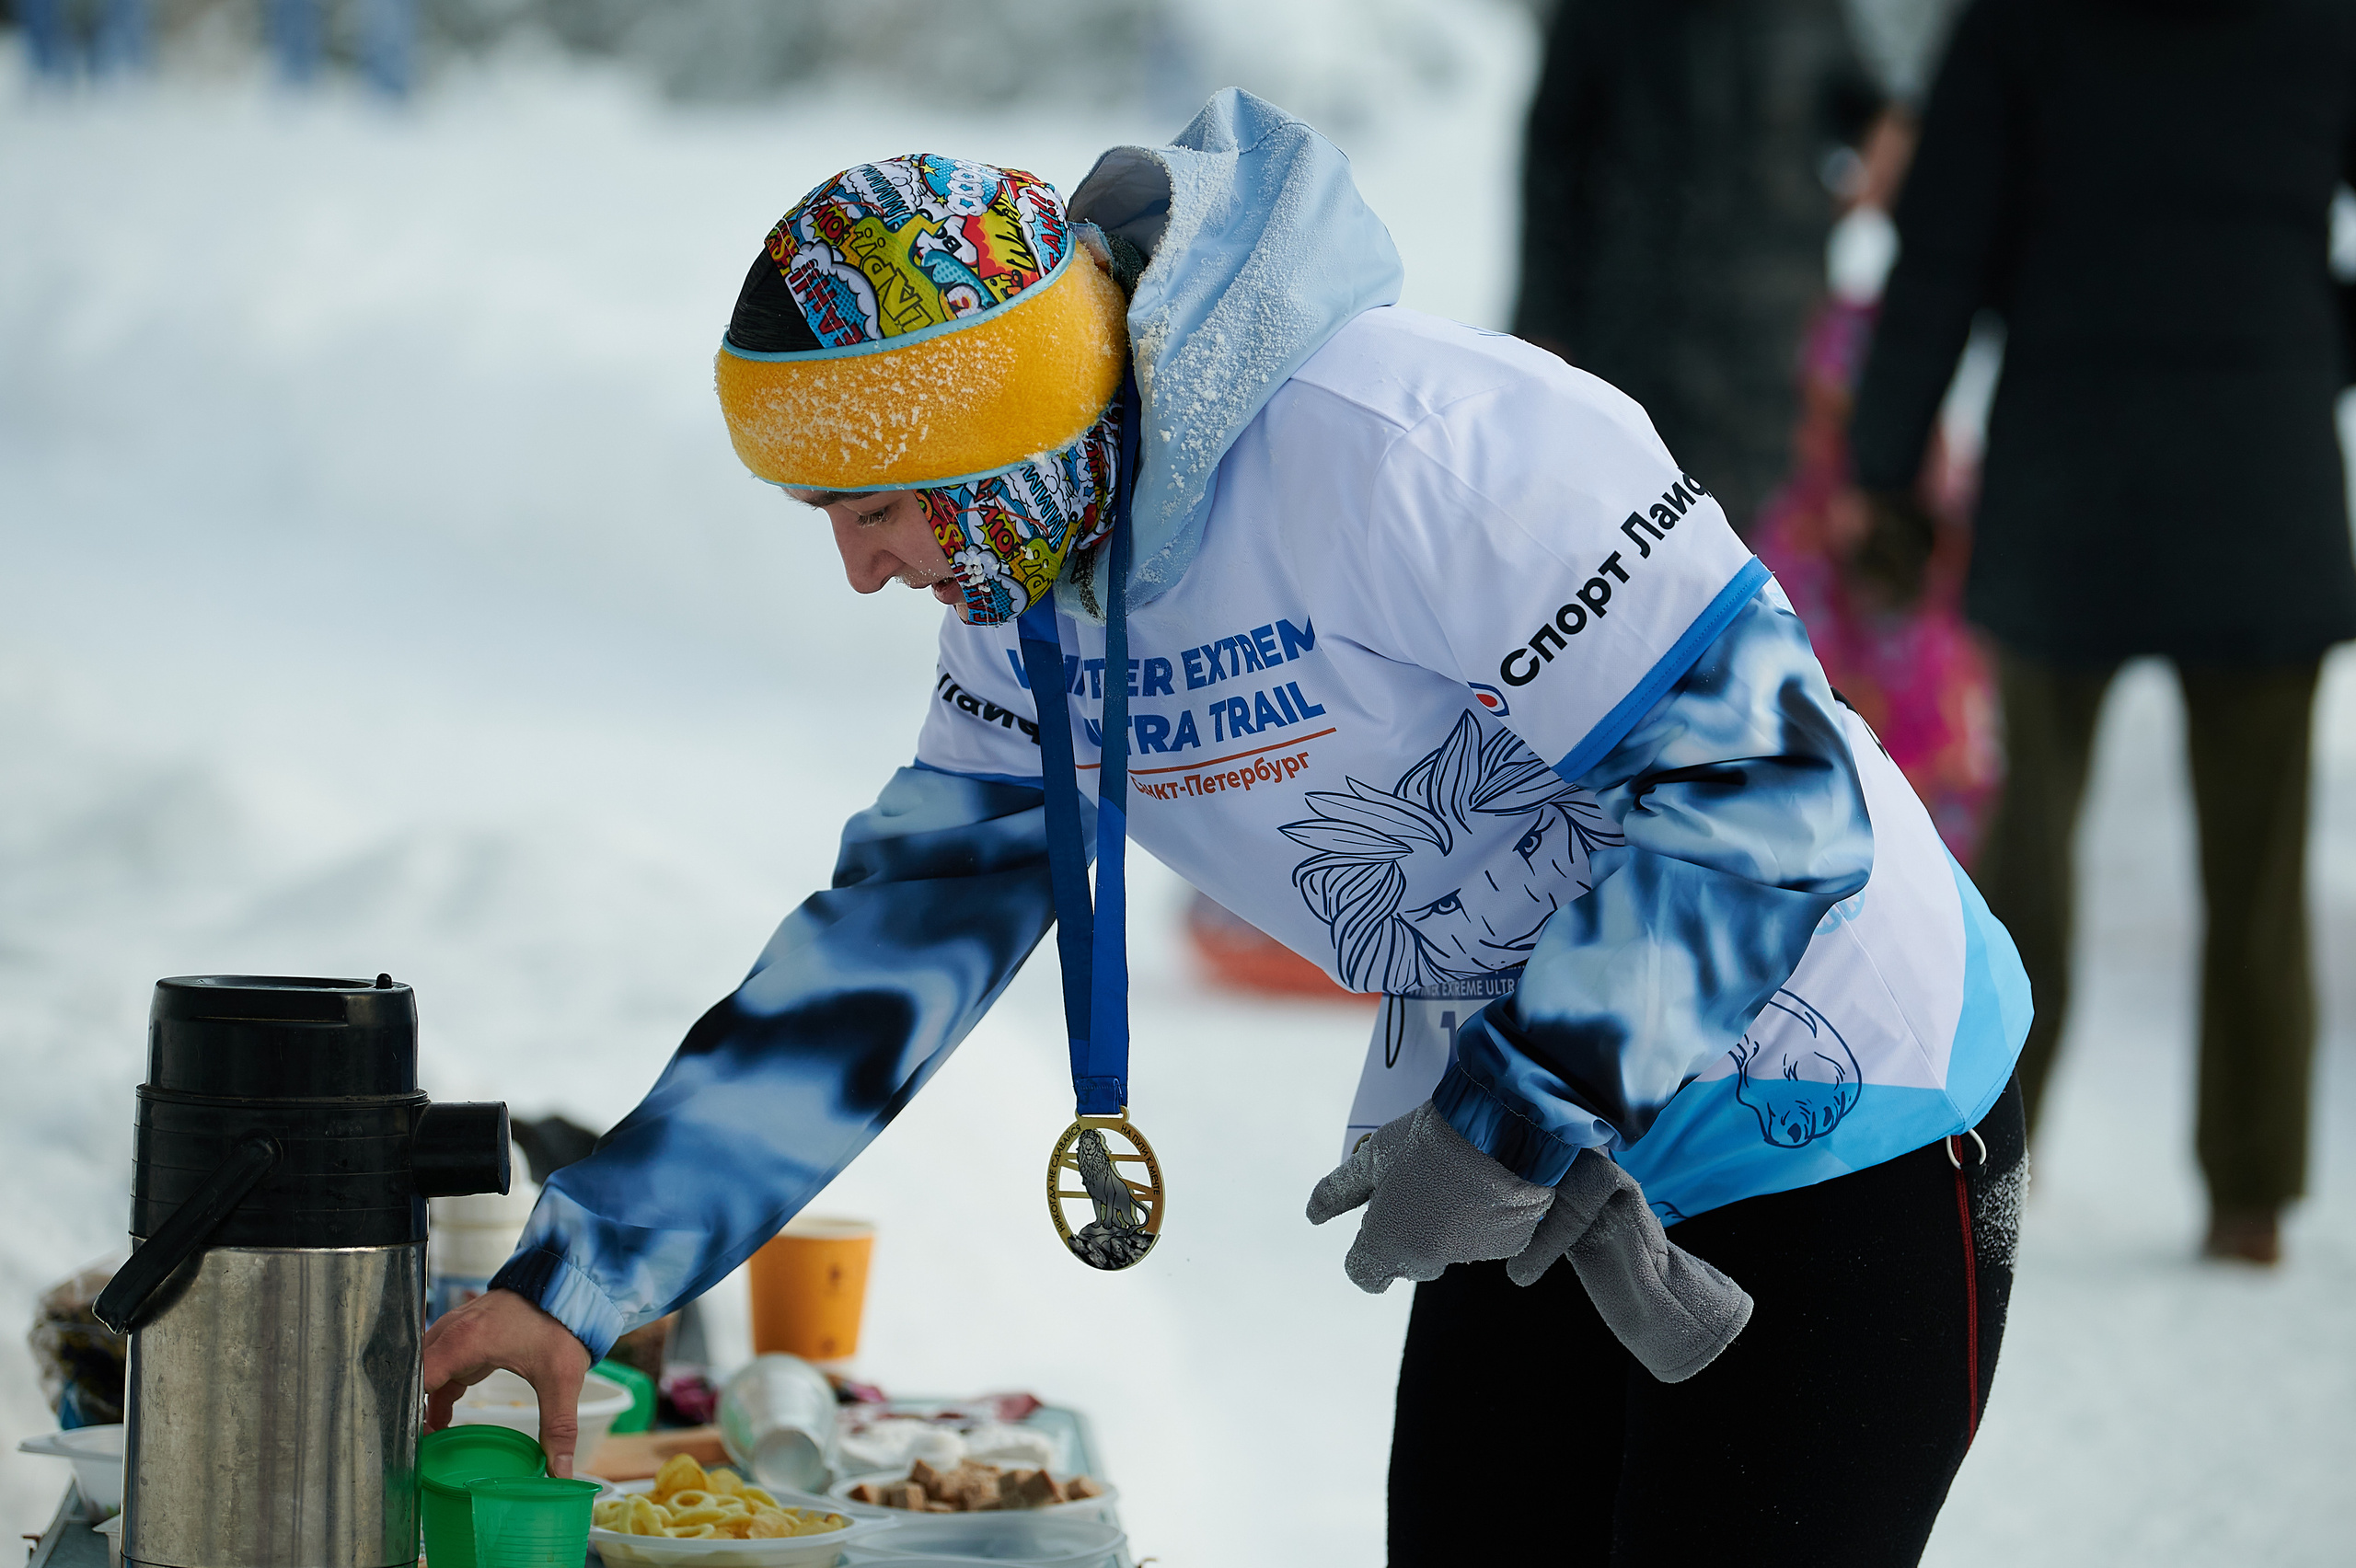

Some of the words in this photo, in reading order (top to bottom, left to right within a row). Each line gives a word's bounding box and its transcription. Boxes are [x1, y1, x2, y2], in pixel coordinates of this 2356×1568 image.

[1500, 550, 1631, 687] Спорт
[1006, 648, 1175, 699] WTER
[1083, 709, 1201, 756] URA
[1208, 680, 1326, 744] TRAIL
[1442, 979, 1483, 997] EXTREME
[1485, 978, 1517, 996] ULTR
[1052, 1124, 1081, 1168] СДАВАЙСЯ
[1121, 1124, 1132, 1139] НА
[1131, 1133, 1150, 1158] ПУТИ
[1149, 1164, 1161, 1196] МЕЧТЕ
[1048, 1169, 1057, 1182] НЕ
[1049, 1186, 1066, 1232] НИКОГДА
